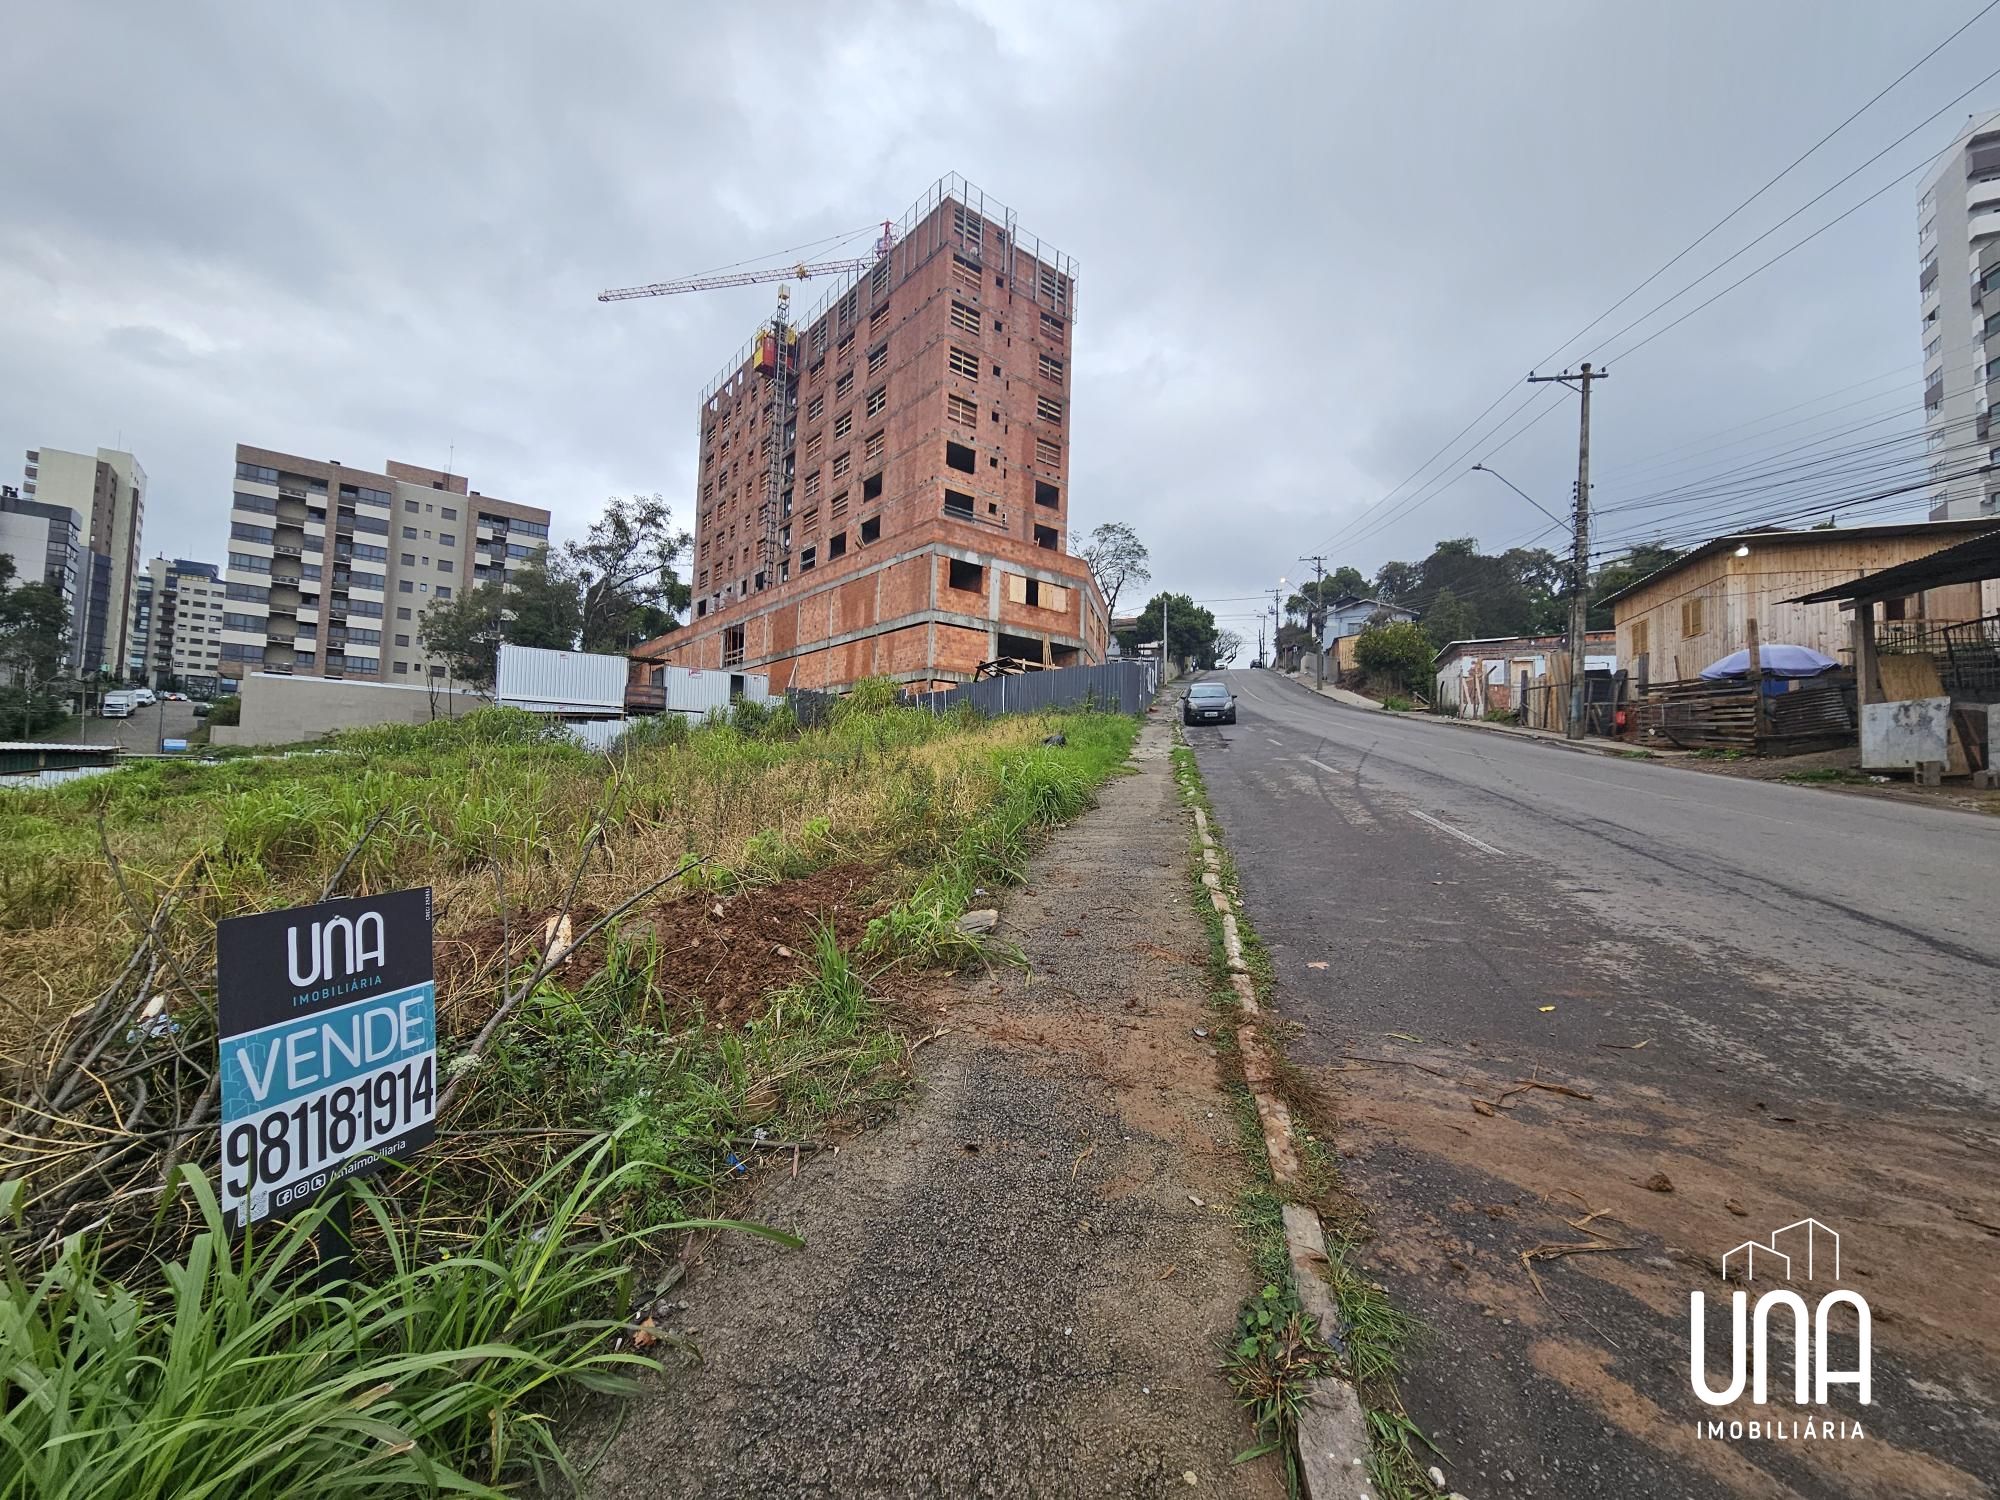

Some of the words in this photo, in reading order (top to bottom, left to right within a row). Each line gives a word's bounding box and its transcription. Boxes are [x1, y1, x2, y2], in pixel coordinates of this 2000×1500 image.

[287, 911, 385, 987] UNA
[293, 975, 382, 1007] IMOBILIÁRIA
[236, 996, 425, 1102] VENDE
